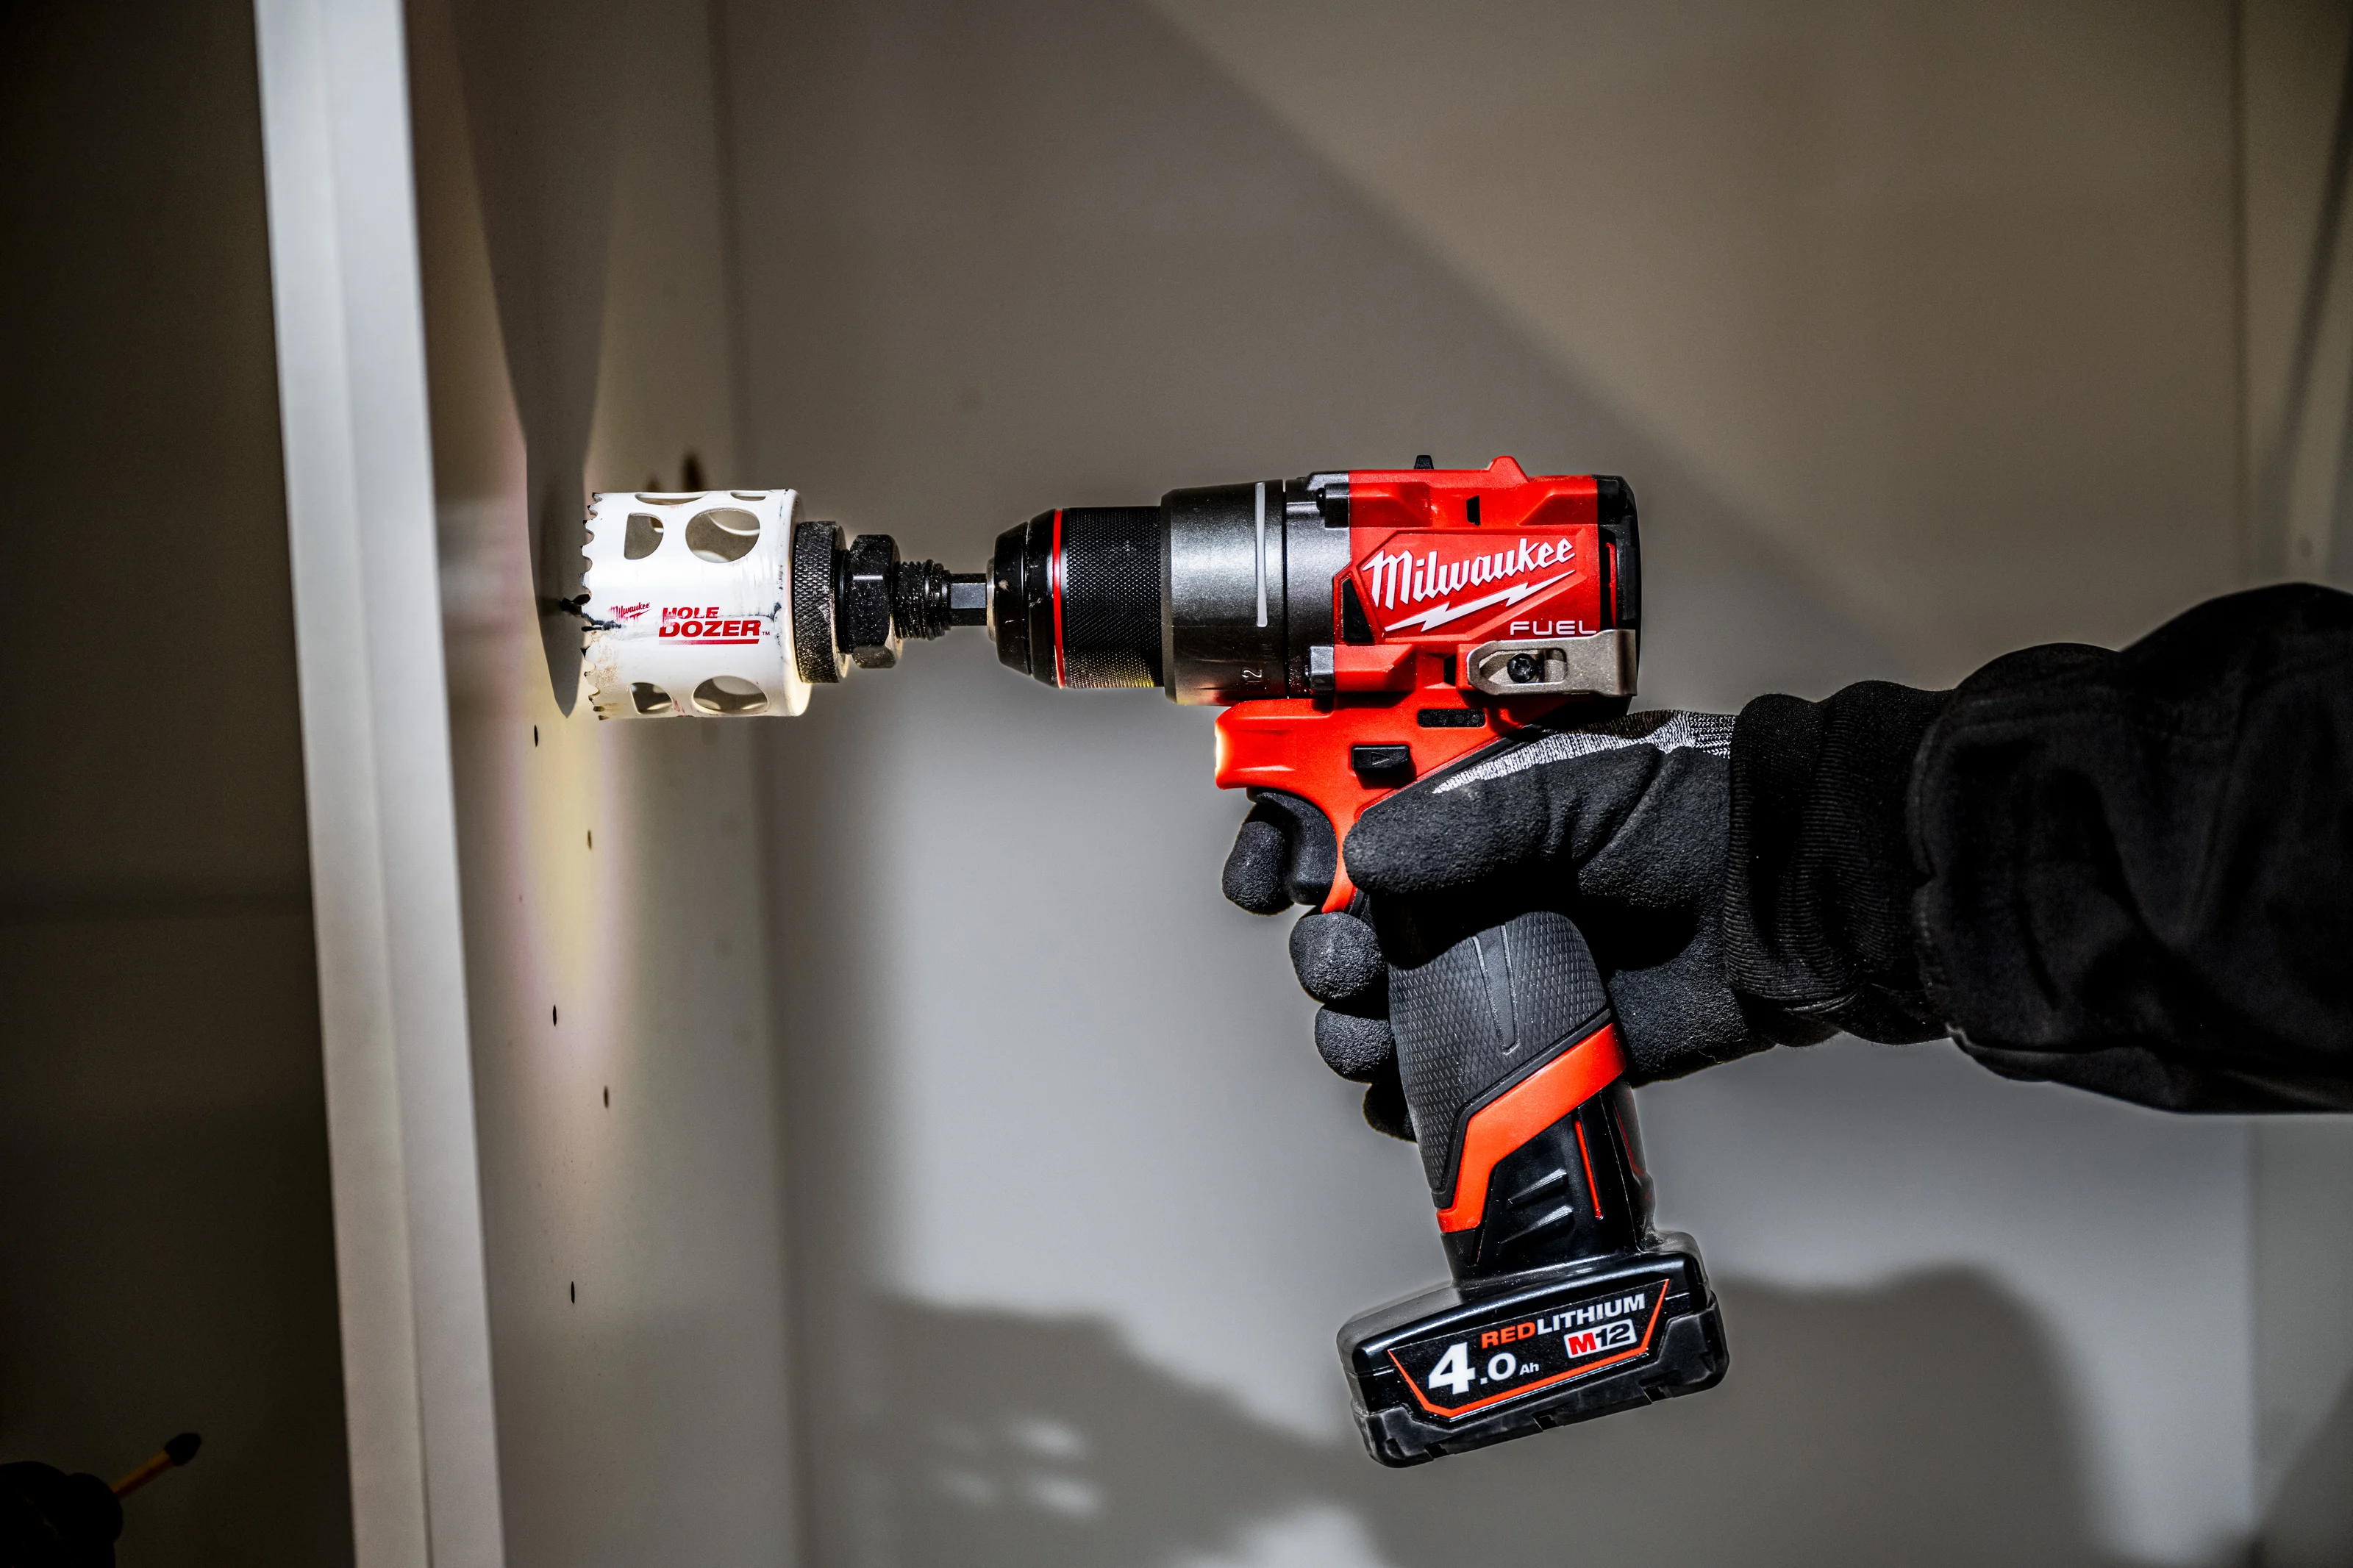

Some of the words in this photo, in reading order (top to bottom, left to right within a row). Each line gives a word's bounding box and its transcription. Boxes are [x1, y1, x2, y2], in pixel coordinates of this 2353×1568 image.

[1362, 537, 1576, 610] Milwaukee
[663, 606, 719, 618] HOLE
[1510, 620, 1597, 635] FUEL
[659, 620, 761, 637] DOZER
[1481, 1294, 1645, 1349] REDLITHIUM
[1568, 1325, 1632, 1356] M12
[1428, 1342, 1517, 1395] 4.0
[1519, 1361, 1540, 1375] Ah
